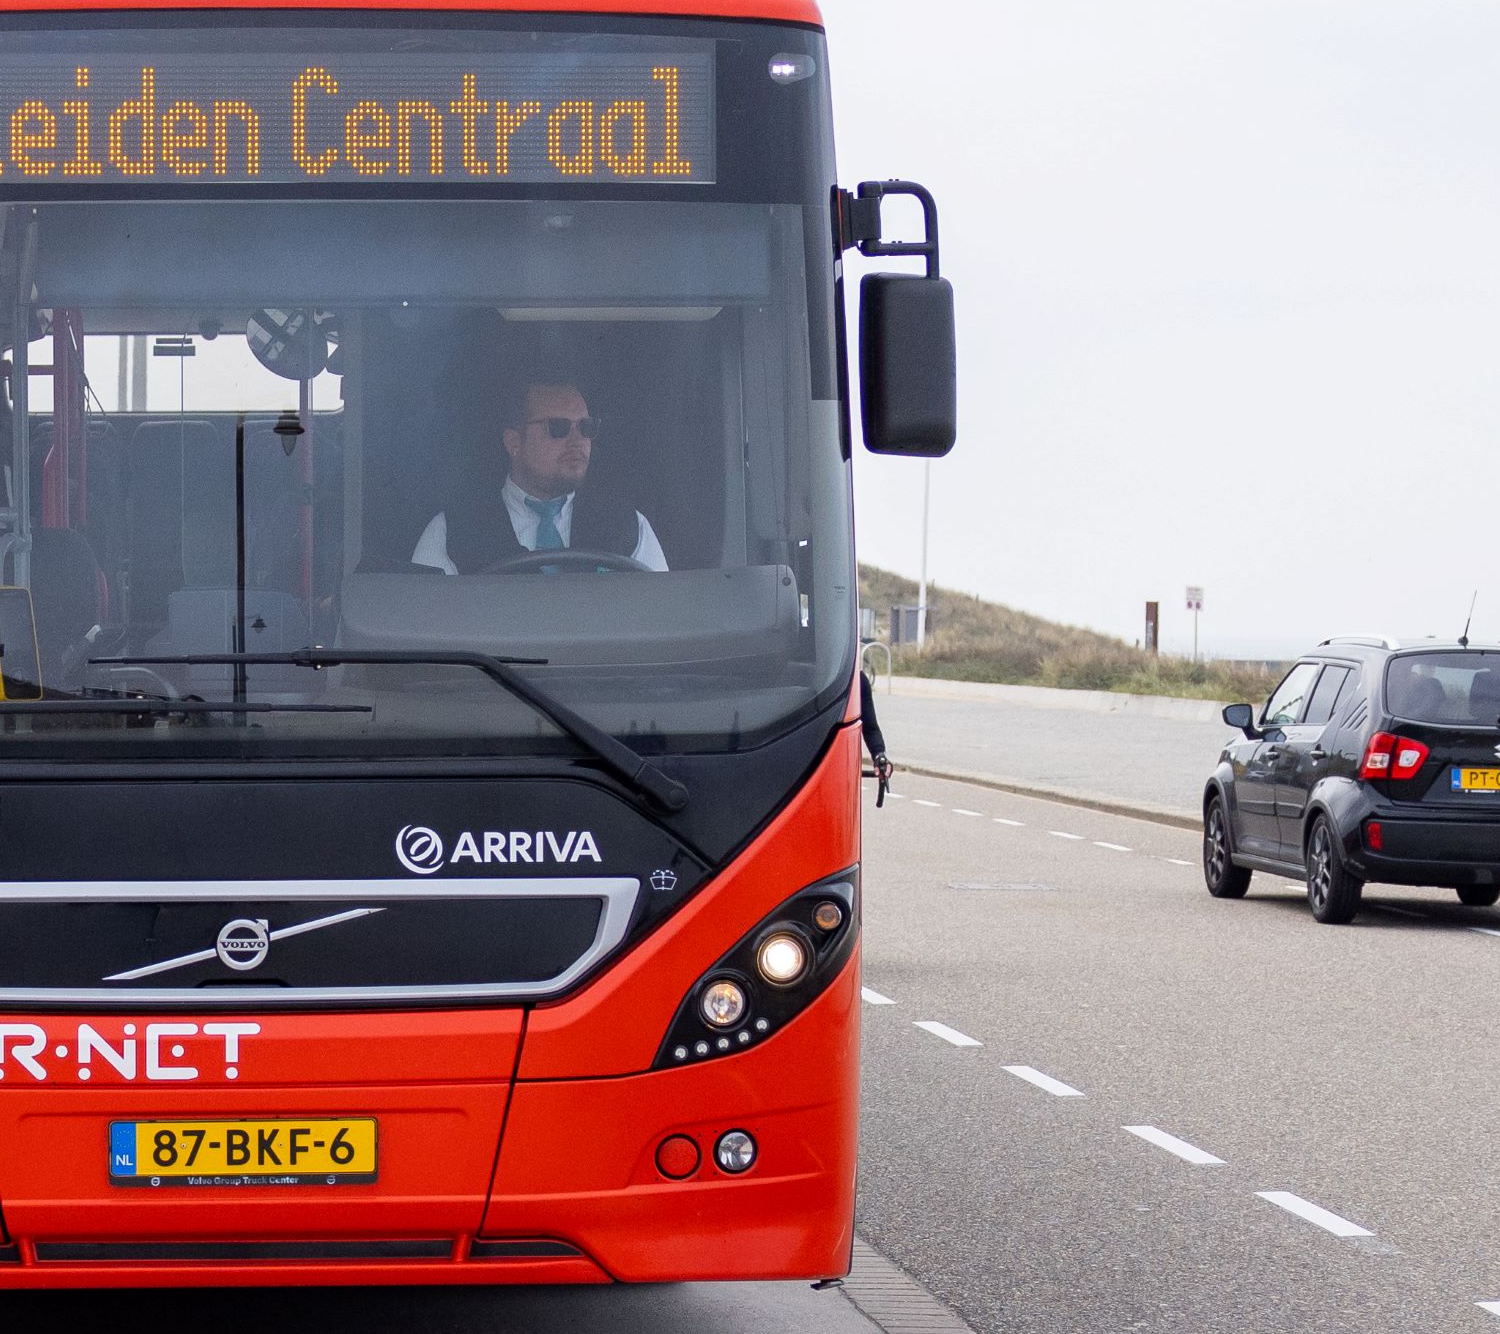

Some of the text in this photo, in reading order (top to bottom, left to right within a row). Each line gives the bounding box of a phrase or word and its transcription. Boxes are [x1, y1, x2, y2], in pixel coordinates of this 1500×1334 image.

[291, 66, 692, 177] Centraal
[450, 831, 602, 863] ARRIVA
[220, 941, 266, 949] VOLVO
[152, 1127, 355, 1167] 87-BKF-6
[116, 1154, 133, 1167] NL
[187, 1176, 299, 1186] Volvo Group Truck Center
